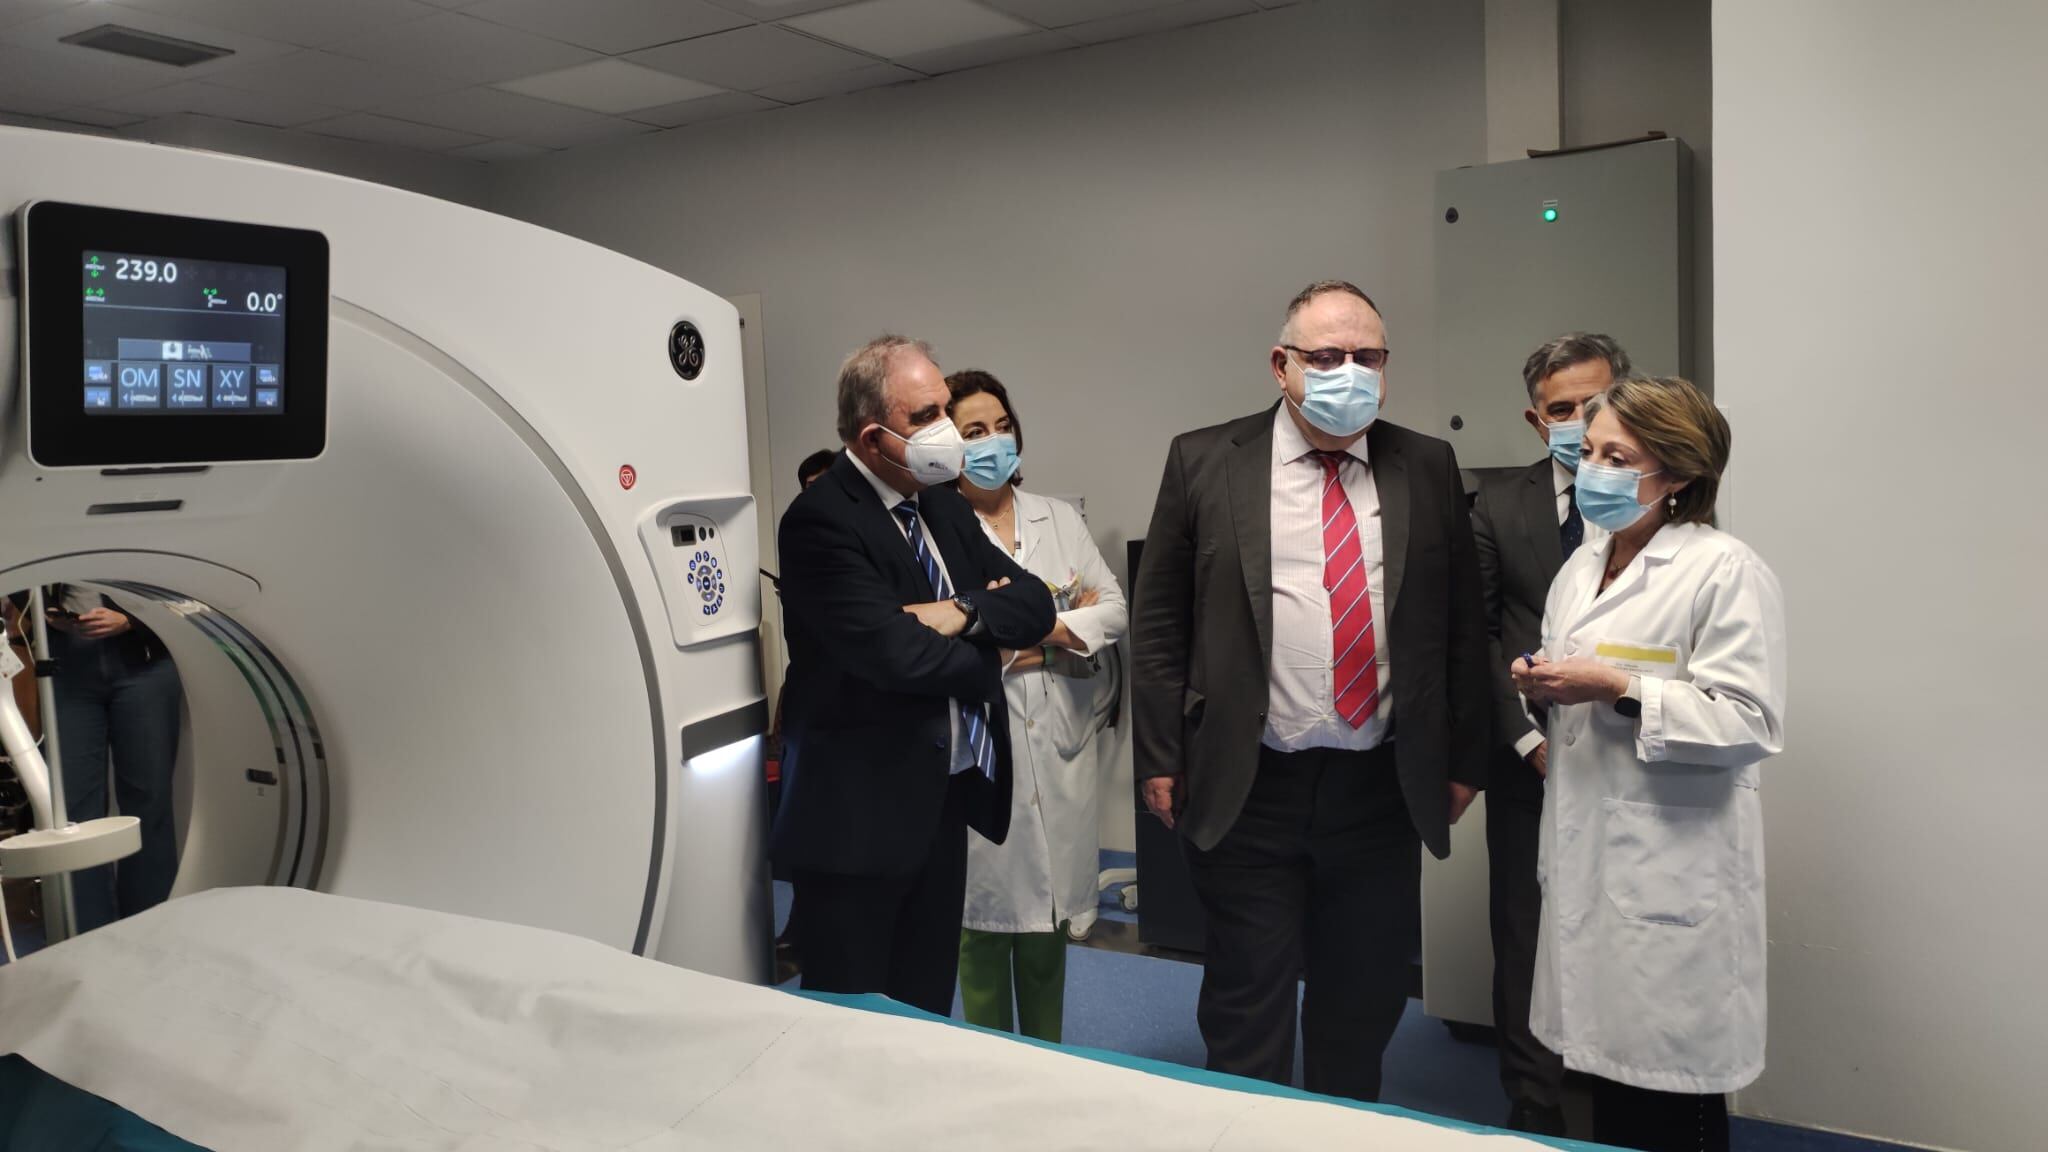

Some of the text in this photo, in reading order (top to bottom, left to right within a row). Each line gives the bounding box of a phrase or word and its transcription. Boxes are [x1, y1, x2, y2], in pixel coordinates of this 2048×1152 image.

[115, 257, 178, 283] 239.0
[247, 292, 283, 312] 0.0°
[121, 367, 158, 388] OM
[173, 368, 201, 389] SN
[219, 369, 245, 389] XY
